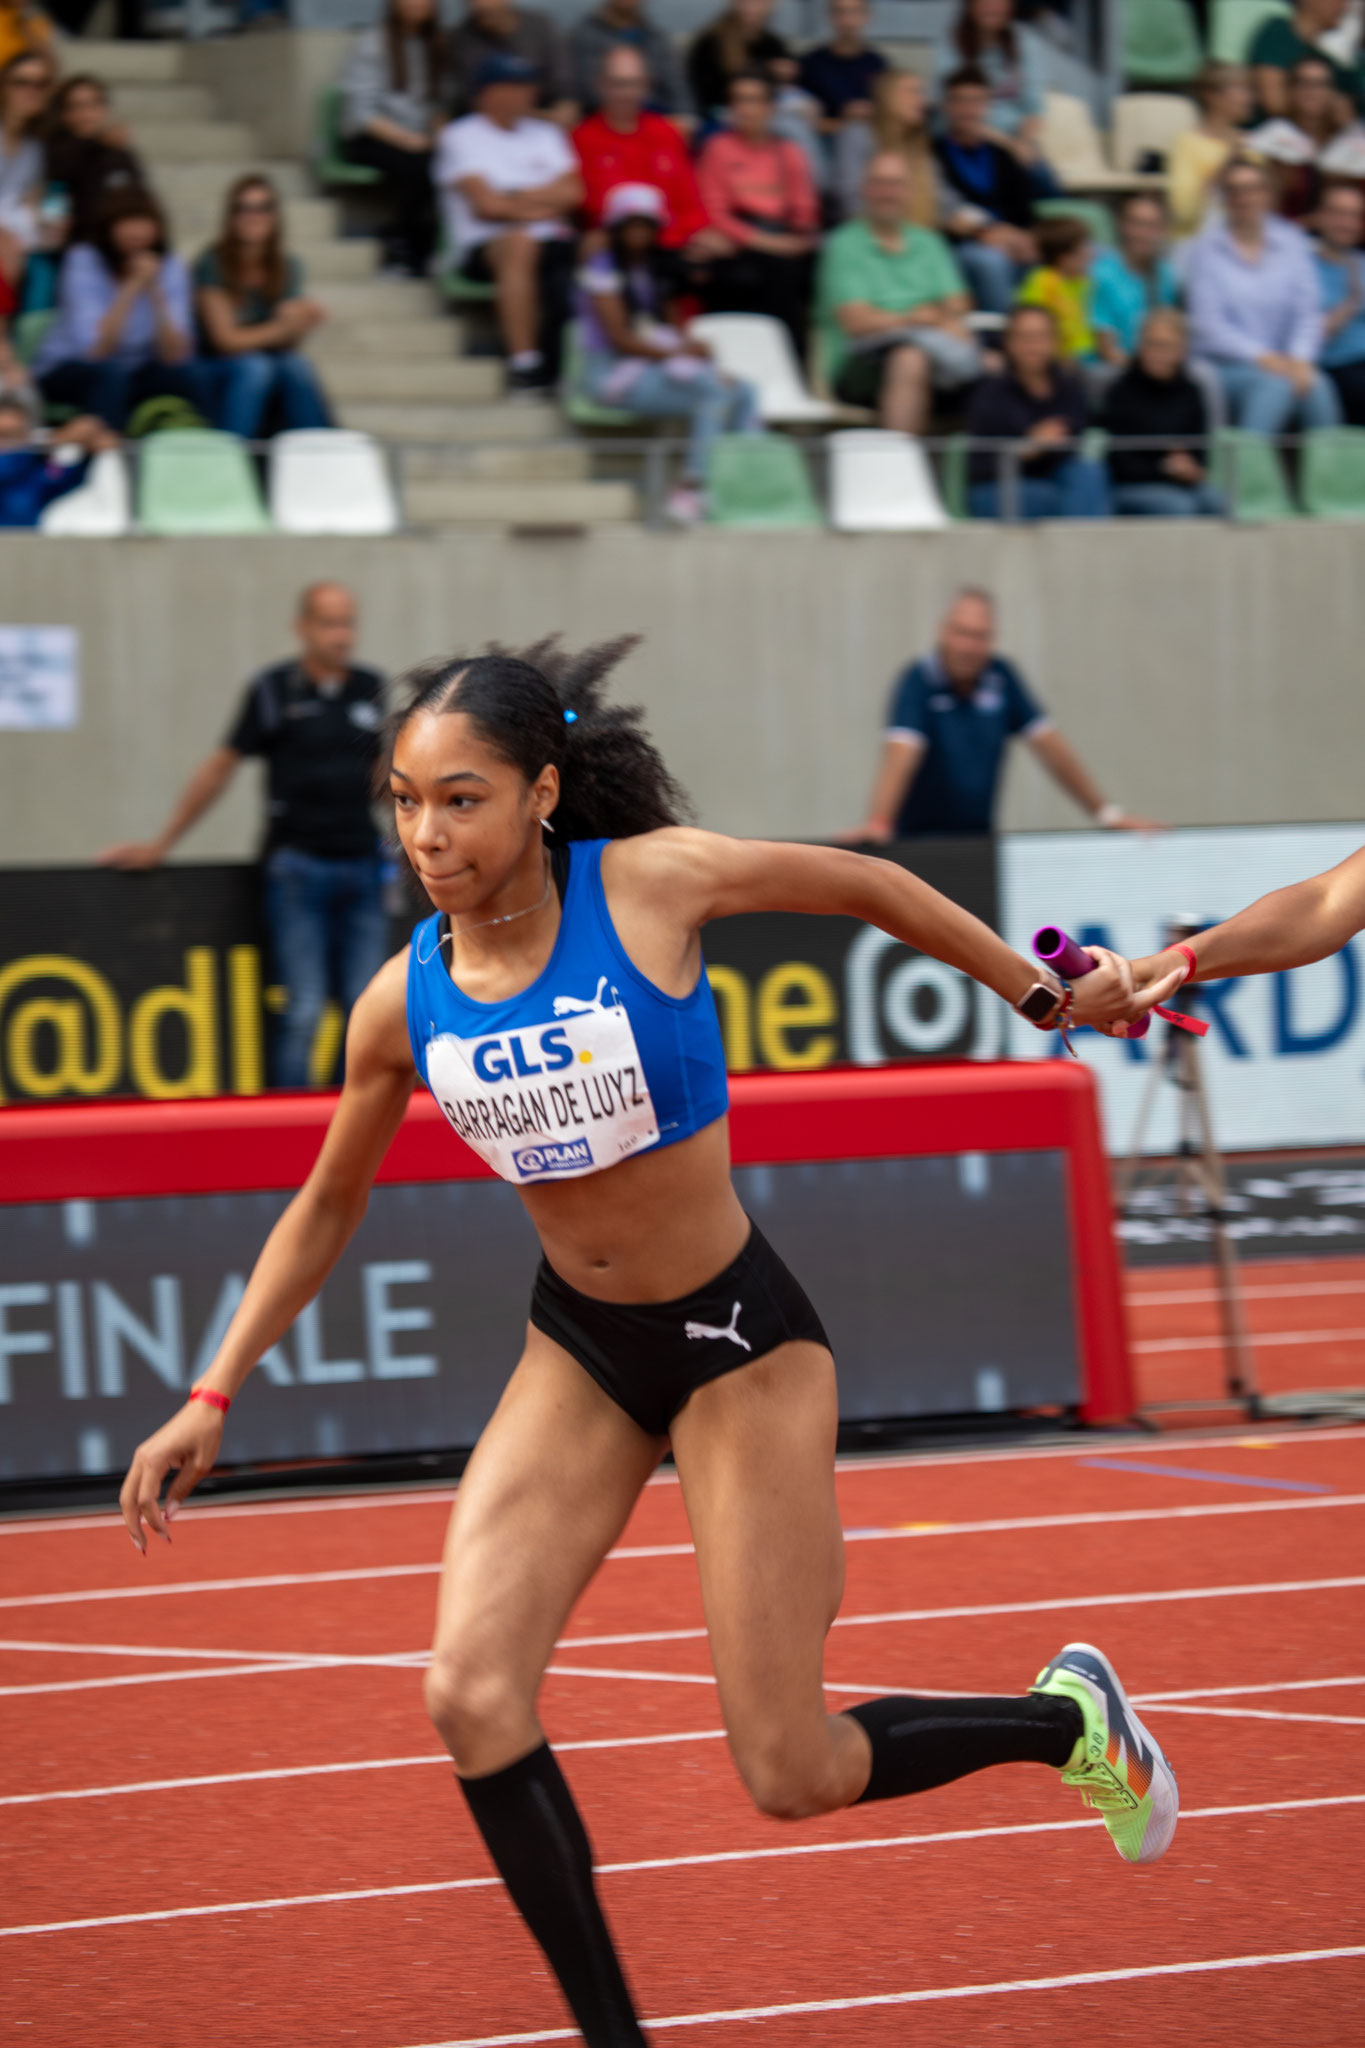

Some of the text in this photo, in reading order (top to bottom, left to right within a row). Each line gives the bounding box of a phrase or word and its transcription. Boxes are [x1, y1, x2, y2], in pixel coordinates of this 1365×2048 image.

[443, 1066, 644, 1141] BARRAGAN DE LUYZ
[545, 1142, 589, 1165] PLAN
[0, 1261, 438, 1405] FINALE
